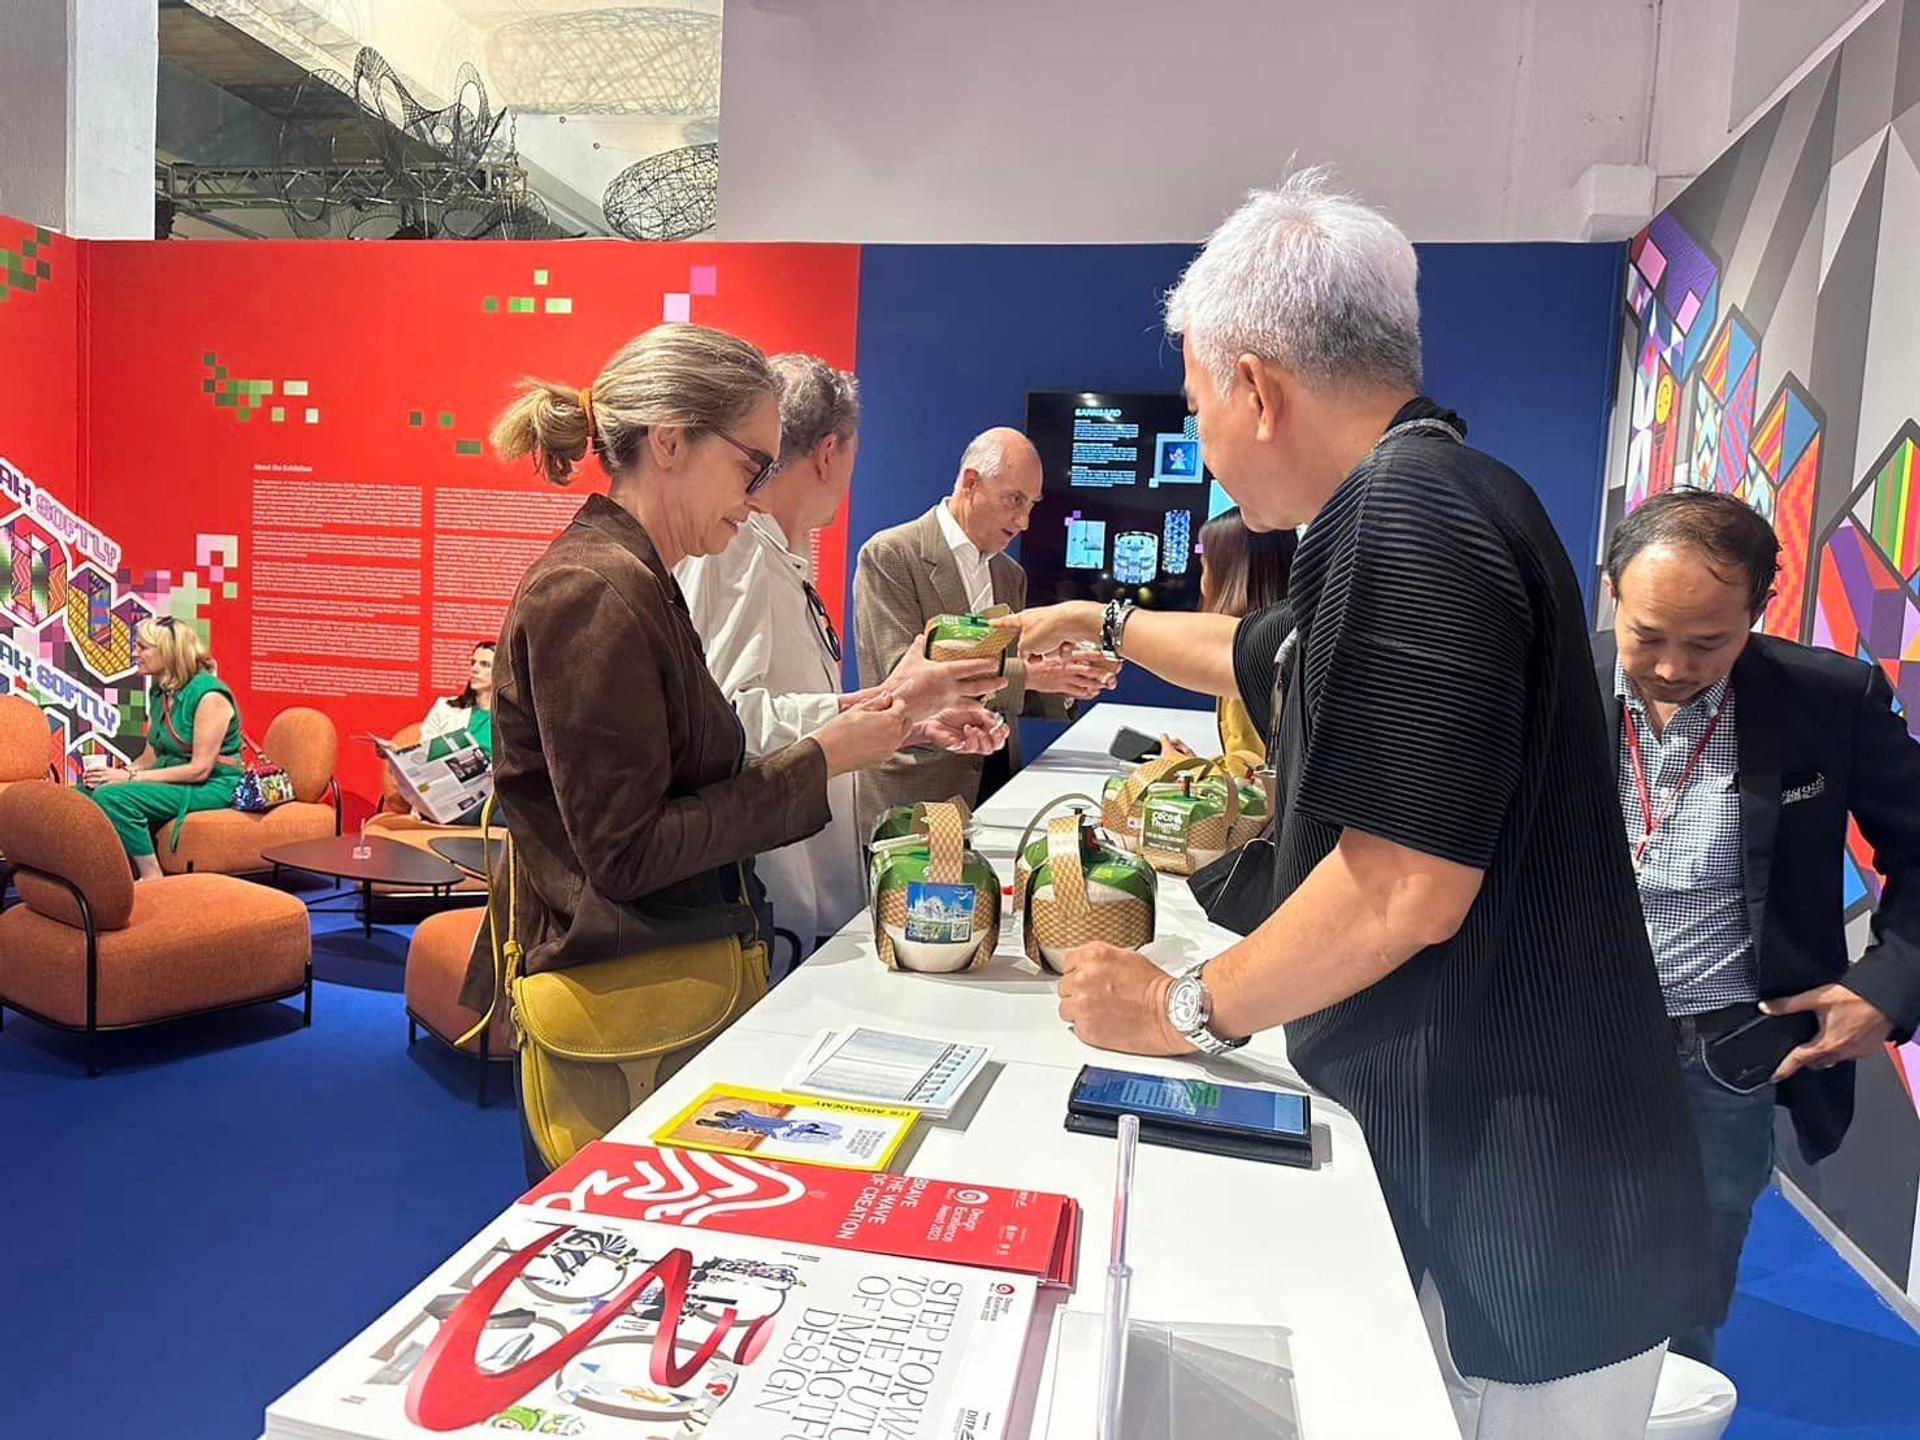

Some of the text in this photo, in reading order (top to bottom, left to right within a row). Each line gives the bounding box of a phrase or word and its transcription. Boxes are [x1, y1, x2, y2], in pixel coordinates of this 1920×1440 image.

[36, 494, 117, 567] SOFTLY
[36, 664, 117, 731] SOFTLY
[867, 1174, 909, 1225] THE WAVE
[869, 1173, 888, 1186] OF
[900, 1177, 929, 1208] BRAVE
[835, 1186, 881, 1239] CREATION
[961, 1207, 984, 1232] Design
[853, 1275, 891, 1312] OF
[890, 1276, 930, 1308] TO
[915, 1280, 963, 1342] STEP
[754, 1308, 839, 1415] DESIGN
[863, 1314, 916, 1363] THE
[781, 1314, 876, 1440] IMPACTF
